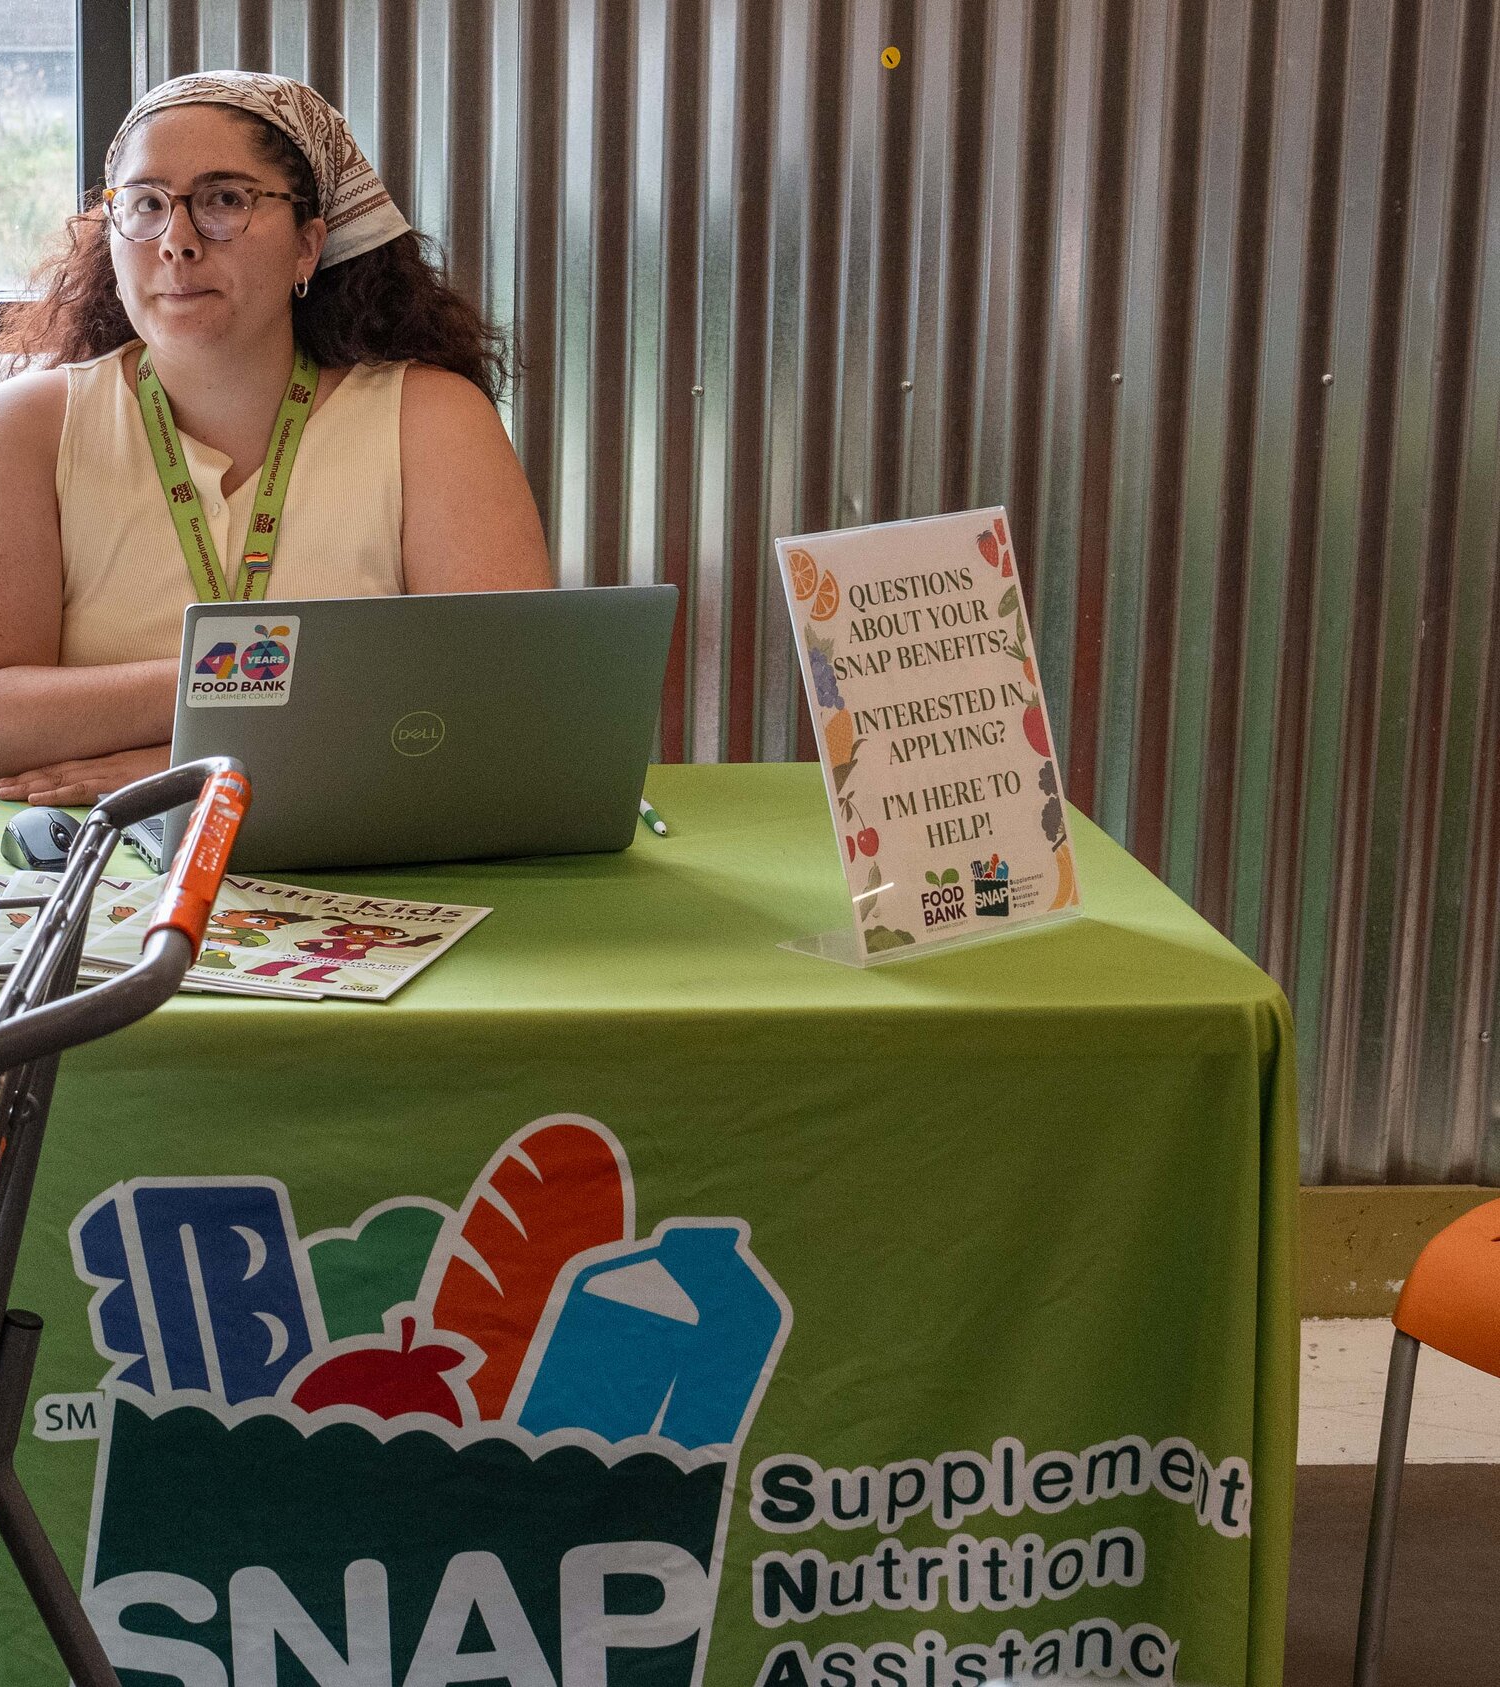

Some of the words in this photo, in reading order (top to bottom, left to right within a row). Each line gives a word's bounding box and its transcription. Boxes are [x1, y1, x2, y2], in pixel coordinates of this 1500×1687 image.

[152, 390, 177, 467] foodbanklarimer.org
[264, 418, 295, 497] foodbanklarimer.org
[190, 517, 221, 600] foodbanklarimer.org
[849, 567, 973, 612] QUESTIONS
[849, 609, 921, 644] ABOUT
[927, 599, 989, 629] YOUR
[247, 656, 285, 664] YEARS
[833, 649, 892, 681] SNAP
[897, 629, 1008, 670] BENEFITS?
[192, 682, 238, 693] FOOD
[241, 681, 286, 692] BANK
[249, 692, 285, 700] COUNTY
[853, 687, 996, 735] INTERESTED
[1000, 682, 1025, 707] IN
[399, 728, 438, 740] DELL
[889, 720, 1007, 765] APPLYING?
[882, 791, 918, 821] I'M
[922, 777, 986, 813] HERE
[988, 770, 1021, 798] TO
[926, 812, 993, 849] HELP!
[223, 877, 463, 918] Nutri-Kids
[322, 907, 457, 924] Adventure
[921, 885, 964, 910] FOOD
[923, 902, 968, 927] BANK
[975, 887, 1008, 909] SNAP
[192, 967, 308, 987] banklarimer.org
[45, 1402, 96, 1431] SM
[760, 1444, 1246, 1527] Supplement
[764, 1533, 1134, 1618] Nutrition
[92, 1541, 710, 1687] SNAP
[766, 1626, 1180, 1687] Assistanc
